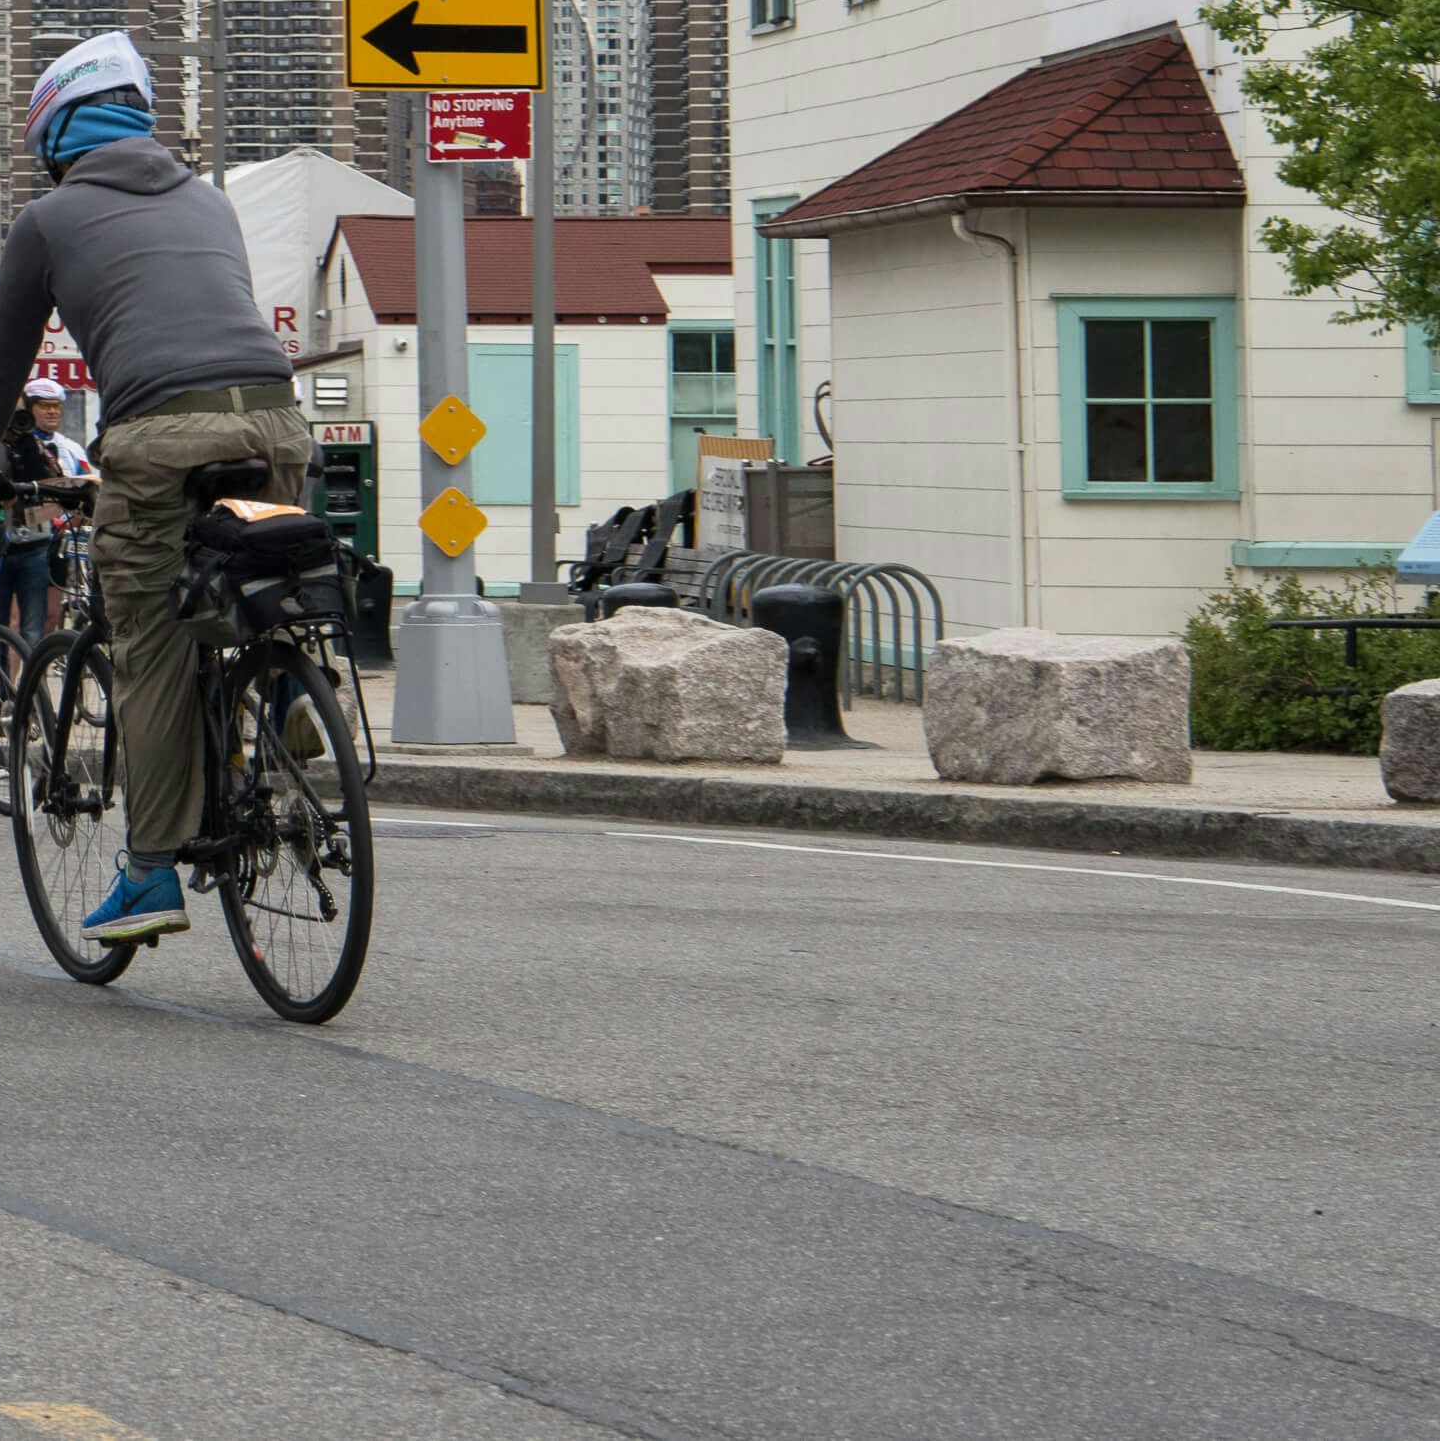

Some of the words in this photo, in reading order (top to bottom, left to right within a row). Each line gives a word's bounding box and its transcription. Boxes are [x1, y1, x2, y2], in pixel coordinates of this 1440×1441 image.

[432, 99, 451, 112] NO
[452, 98, 515, 112] STOPPING
[433, 115, 485, 131] Anytime
[322, 425, 362, 443] ATM
